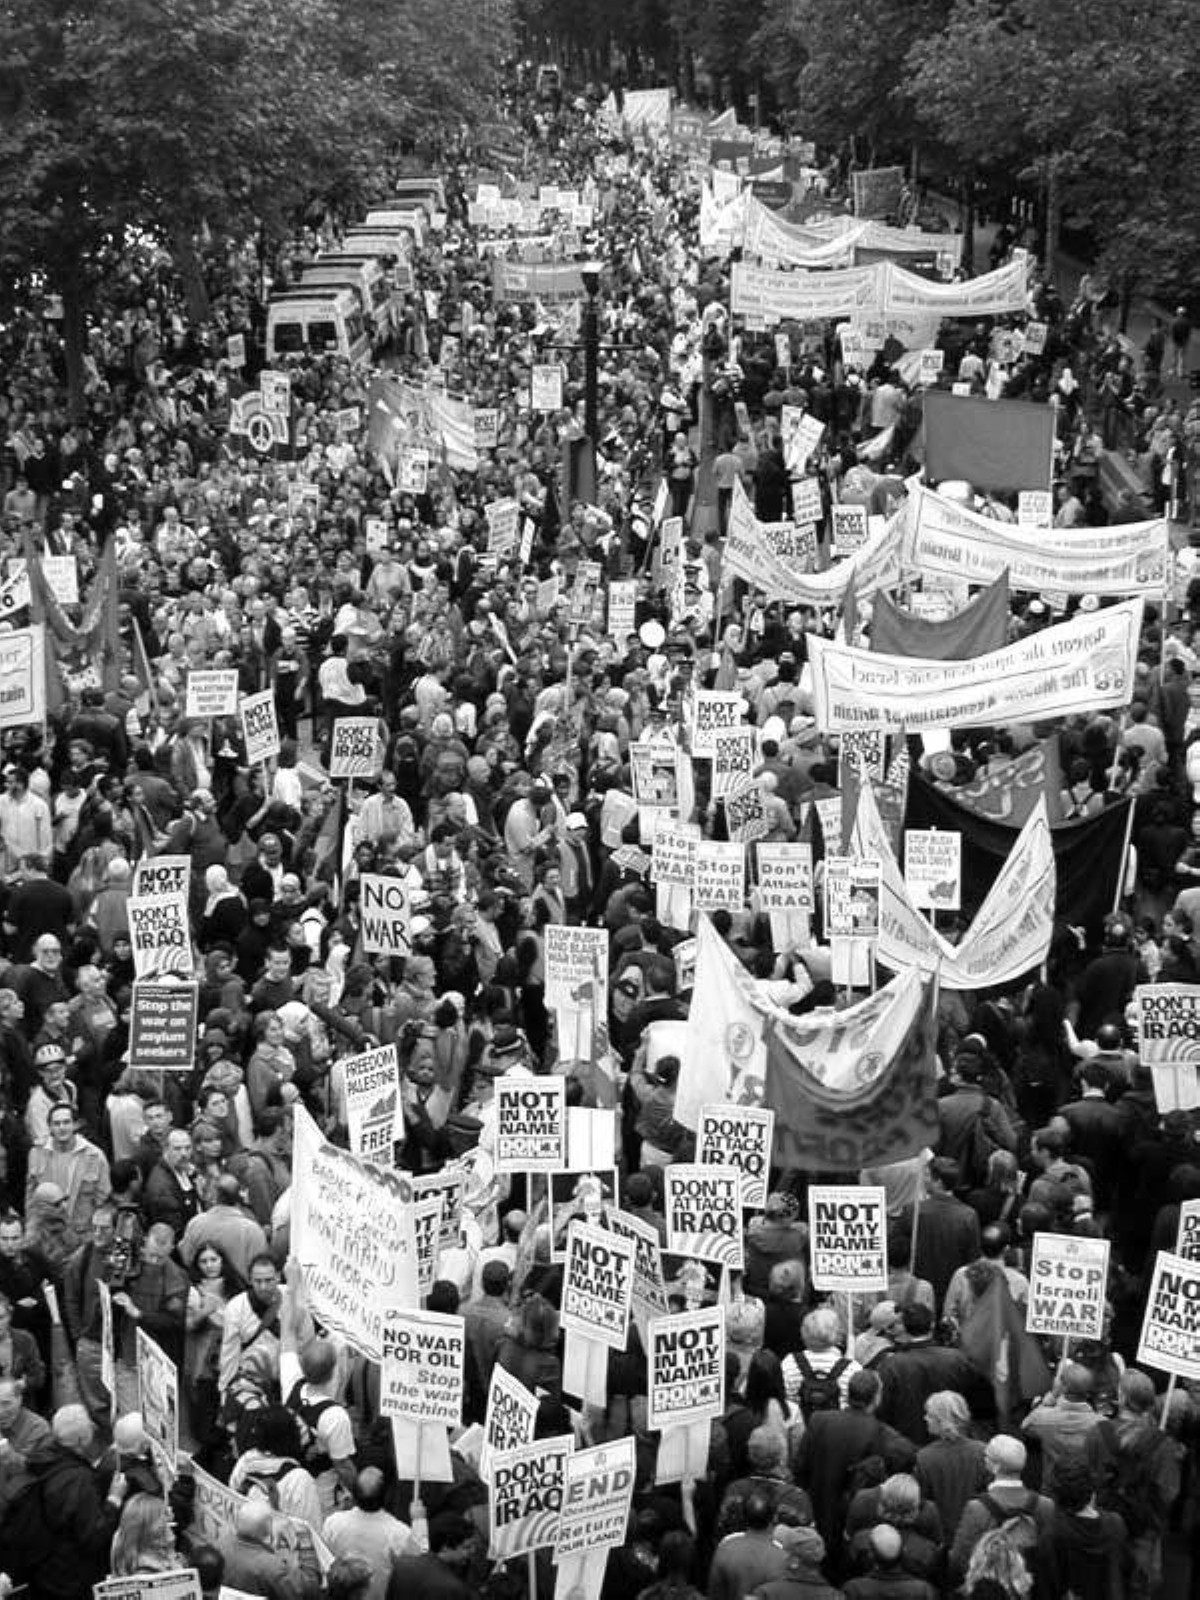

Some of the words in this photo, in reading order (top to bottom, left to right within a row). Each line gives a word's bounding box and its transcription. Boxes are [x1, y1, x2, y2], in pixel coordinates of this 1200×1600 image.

[244, 700, 271, 719] NOT
[699, 702, 737, 713] NOT
[336, 726, 373, 738] DON'T
[335, 744, 373, 757] IRAQ
[716, 737, 750, 749] DON'T
[716, 758, 750, 773] IRAQ
[140, 866, 186, 883] NOT
[655, 859, 695, 876] WAR
[698, 861, 743, 875] Stop
[761, 864, 809, 875] Don't
[140, 883, 159, 896] IN
[160, 880, 184, 894] MY
[763, 879, 808, 889] Attack
[364, 882, 404, 911] NO
[698, 887, 739, 901] WAR
[763, 894, 811, 907] IRAQ
[132, 904, 181, 923] DON'T
[136, 928, 185, 949] IRAQ
[364, 918, 412, 949] WAR
[136, 1000, 168, 1014] Stop
[170, 1000, 192, 1011] the
[140, 1018, 167, 1027] war
[169, 1018, 188, 1027] on
[1144, 1021, 1198, 1040] IRAQ
[138, 1032, 187, 1044] asylum
[346, 1047, 394, 1079] FREEDOM
[347, 1067, 395, 1096] PALESTINE
[500, 1092, 559, 1109] NOT
[500, 1110, 519, 1121] IN
[526, 1110, 558, 1121] MY
[361, 1123, 392, 1153] FREE
[500, 1122, 559, 1135] NAME
[704, 1118, 767, 1139] DON'T
[705, 1135, 765, 1153] ATTACK
[702, 1150, 765, 1178] IRAQ
[671, 1180, 735, 1197] DON'T
[673, 1197, 735, 1211] ATTACK
[816, 1202, 879, 1222] NOT
[673, 1212, 737, 1237] IRAQ
[816, 1222, 837, 1235] IN
[844, 1223, 878, 1236] MY
[816, 1236, 880, 1251] NAME
[572, 1238, 629, 1272] NOT
[570, 1258, 591, 1276] IN
[594, 1267, 626, 1288] MY
[1036, 1260, 1102, 1285] Stop
[568, 1272, 626, 1304] NAME
[1036, 1282, 1098, 1301] Israeli
[1035, 1300, 1096, 1320] WAR
[1155, 1292, 1177, 1311] IN
[1032, 1319, 1095, 1334] CRIMES
[383, 1328, 411, 1345] NO
[416, 1334, 462, 1352] WAR
[655, 1324, 719, 1353] NOT
[383, 1344, 421, 1363] FOR
[428, 1352, 461, 1369] OIL
[655, 1353, 677, 1369] IN
[685, 1345, 718, 1365] MY
[418, 1369, 459, 1388] Stop
[655, 1360, 719, 1385] NAME
[390, 1381, 418, 1397] the
[424, 1390, 461, 1402] war
[382, 1398, 459, 1418] machine
[496, 1453, 567, 1489] DON'T
[497, 1472, 563, 1502] ATTACK
[568, 1470, 631, 1503] END
[496, 1487, 563, 1527] IRAQ
[560, 1515, 625, 1541] Return
[588, 1530, 621, 1545] LAND
